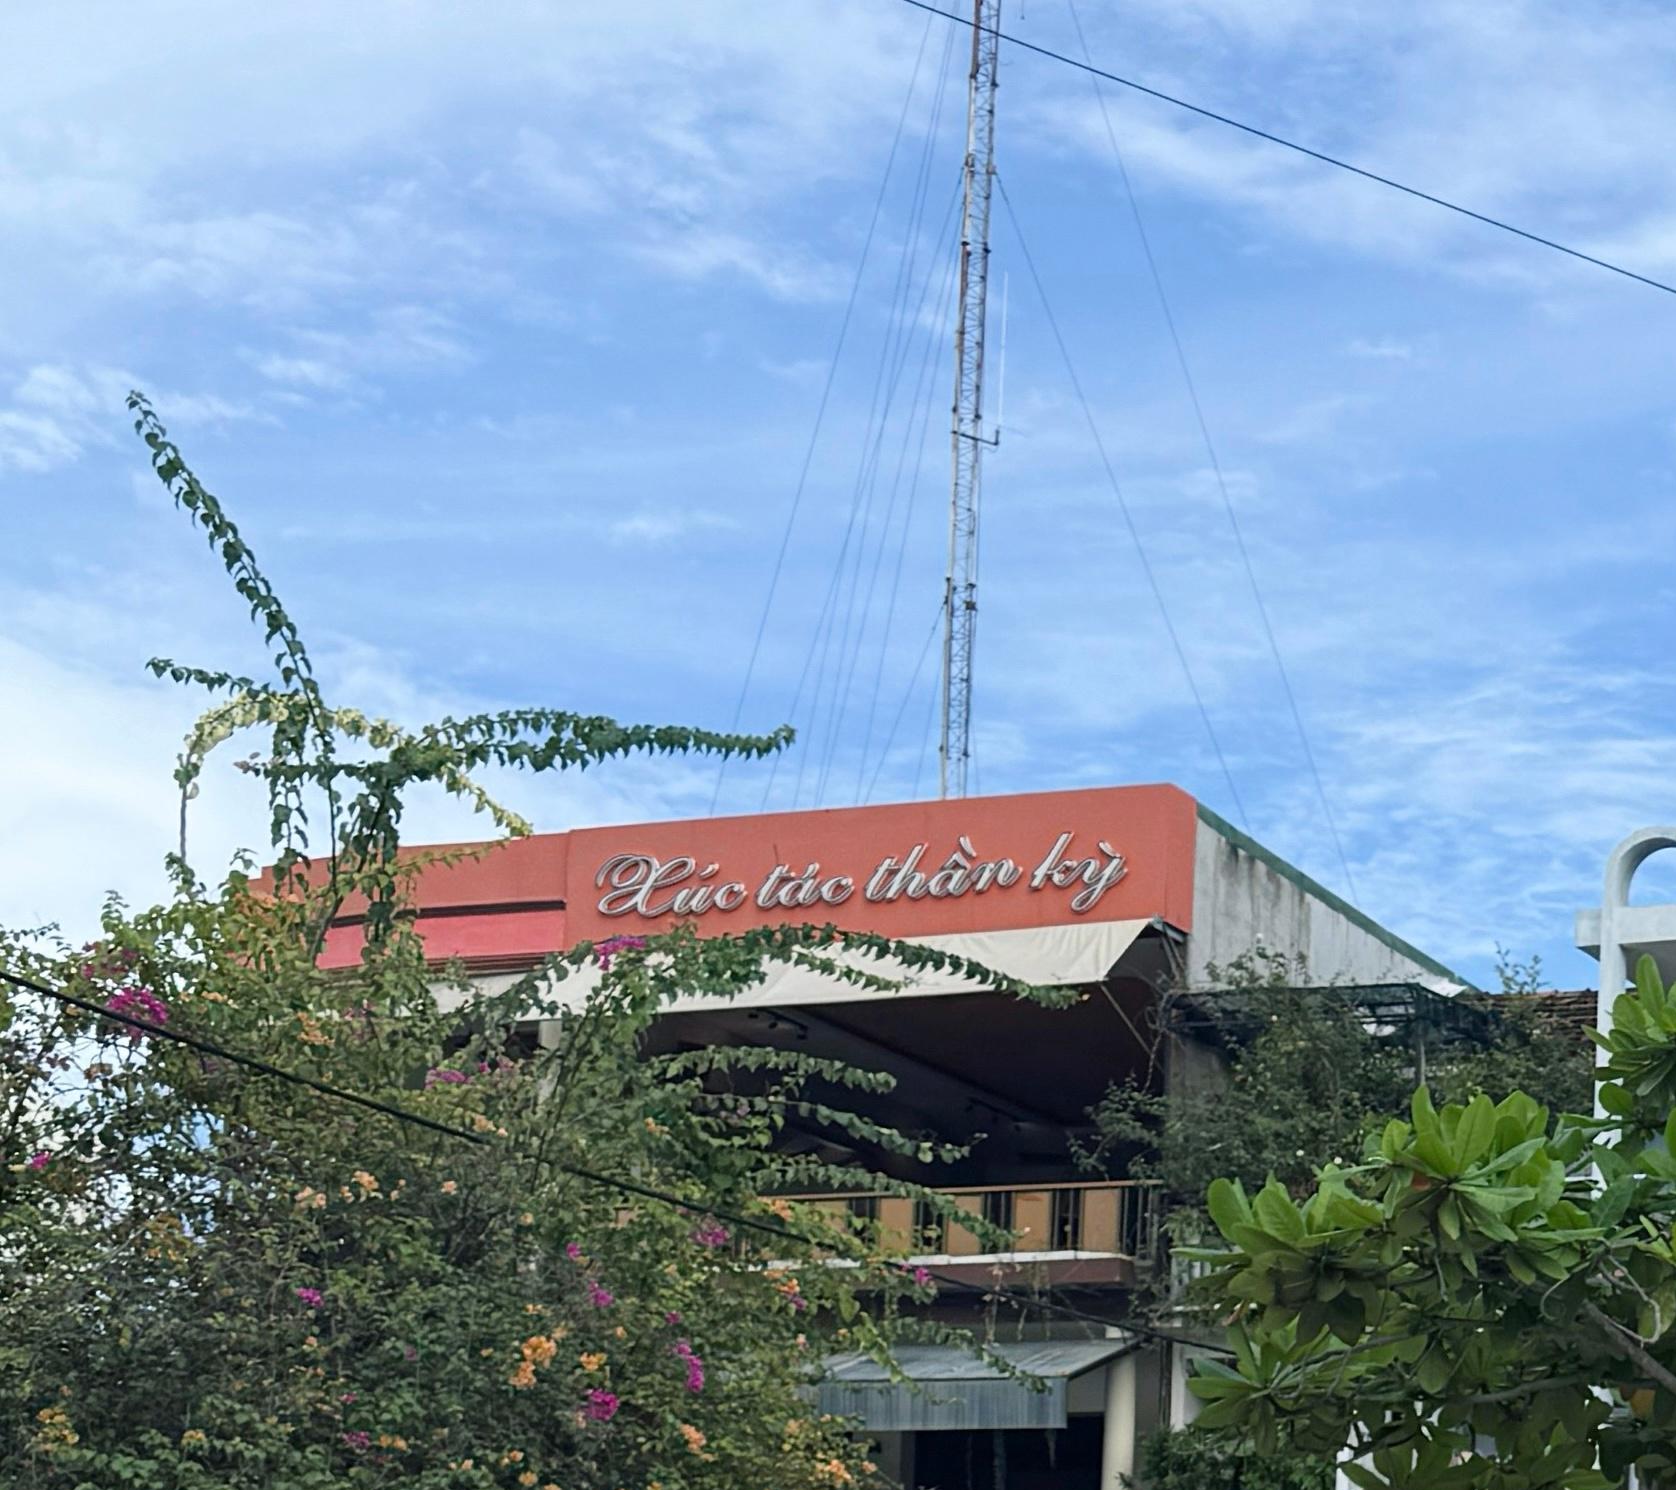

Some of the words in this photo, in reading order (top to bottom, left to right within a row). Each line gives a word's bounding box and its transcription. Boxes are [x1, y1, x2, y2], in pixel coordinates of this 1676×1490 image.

[595, 852, 748, 918] Xúc
[756, 861, 856, 909] tác
[863, 835, 1022, 903] thần
[1029, 830, 1129, 914] kỳ
